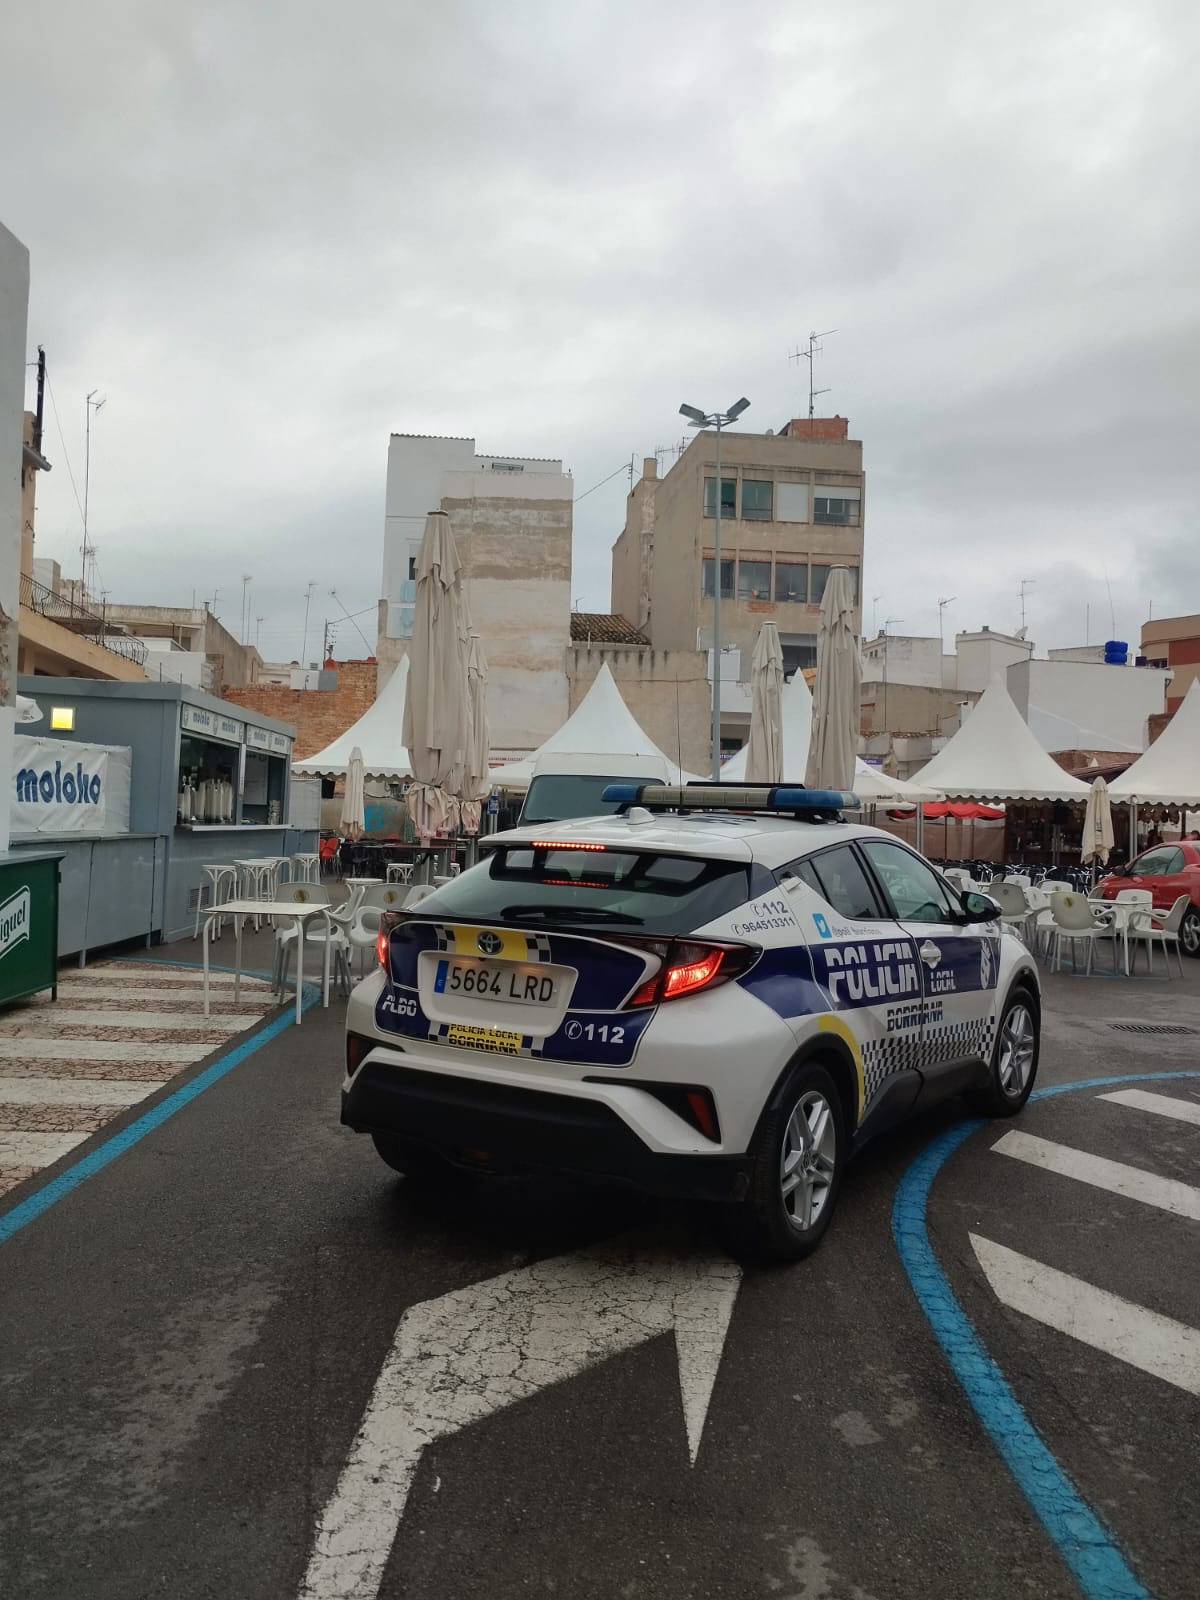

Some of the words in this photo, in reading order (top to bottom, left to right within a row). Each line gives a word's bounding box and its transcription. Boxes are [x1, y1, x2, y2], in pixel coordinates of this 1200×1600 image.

[16, 760, 101, 805] moloko
[763, 901, 789, 915] 112
[0, 900, 26, 943] iguel
[742, 916, 796, 933] 964513311
[450, 966, 501, 995] 5664
[509, 973, 554, 1002] LRD
[824, 942, 919, 1003] POLICIA
[930, 969, 956, 993] LOCAL
[887, 1001, 943, 1032] BORRIANA
[450, 1023, 486, 1036] POLICIA
[489, 1029, 520, 1041] LOCAL
[584, 1023, 625, 1044] 112
[448, 1034, 519, 1055] BORRIANA
